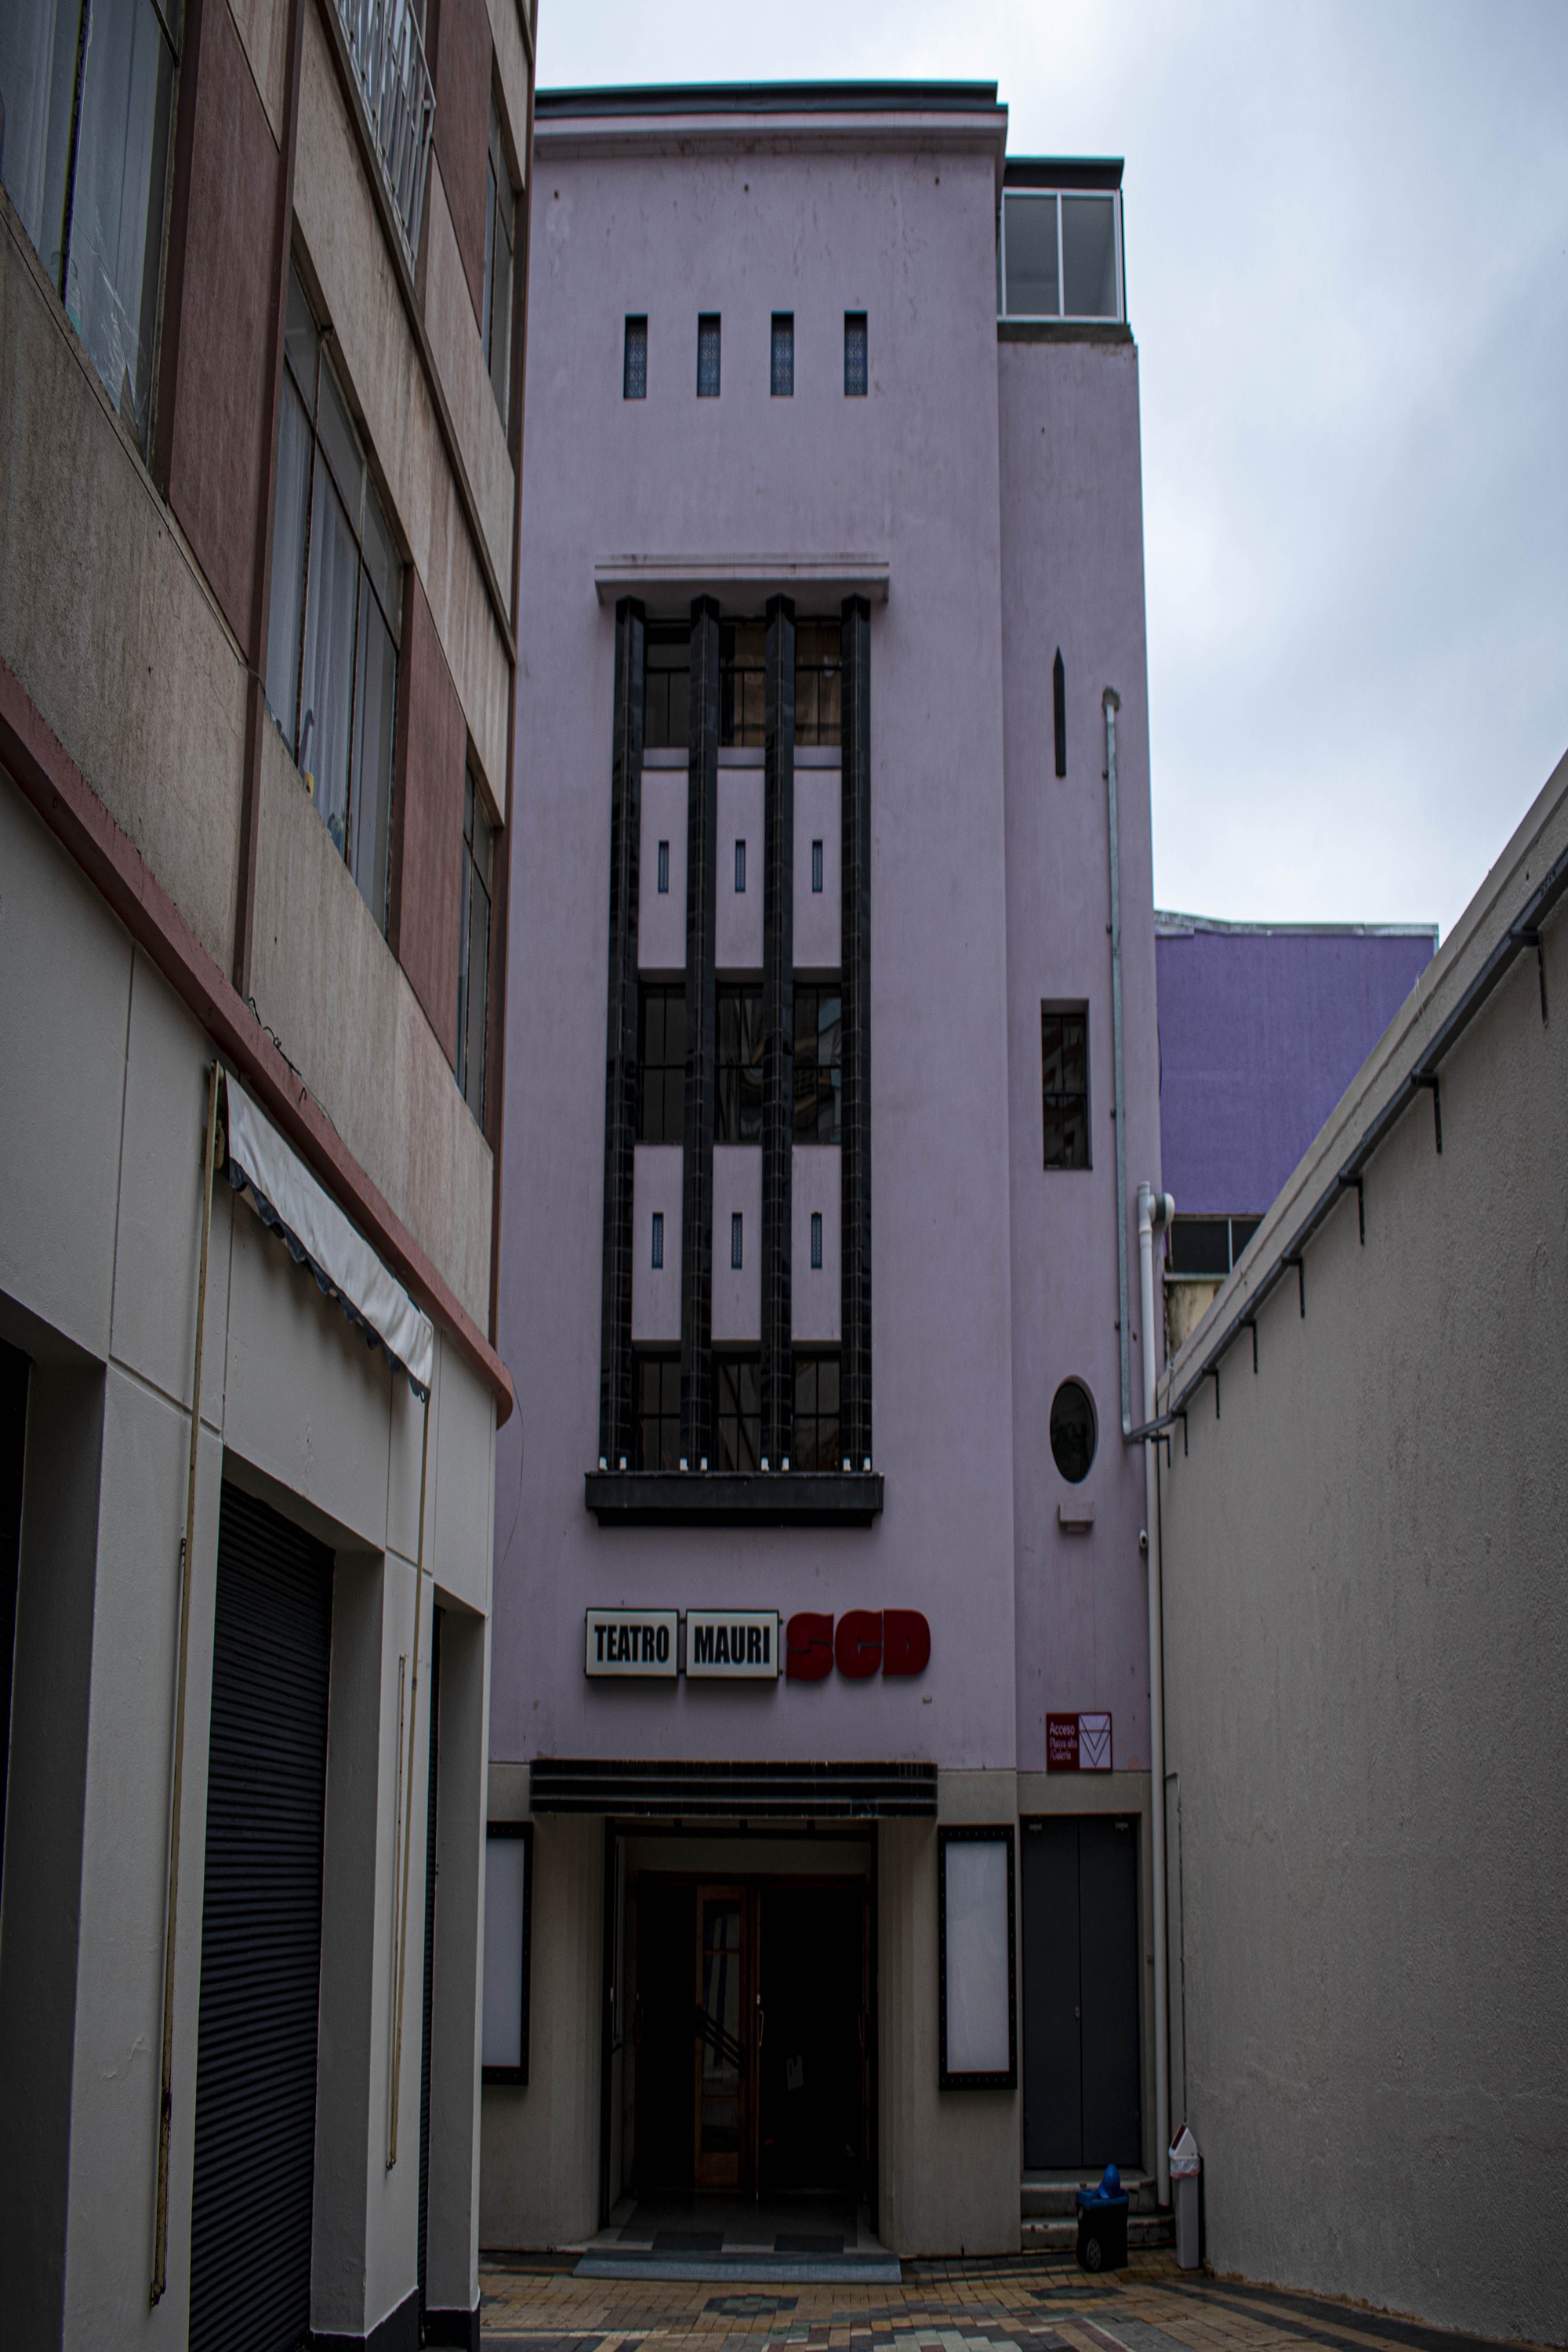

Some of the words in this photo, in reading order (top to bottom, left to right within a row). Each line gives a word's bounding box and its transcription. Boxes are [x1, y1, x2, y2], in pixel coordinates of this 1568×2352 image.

[594, 1624, 670, 1664] TEATRO
[694, 1625, 771, 1664] MAURI
[786, 1609, 931, 1681] SCD
[1050, 1721, 1075, 1736] Acceso
